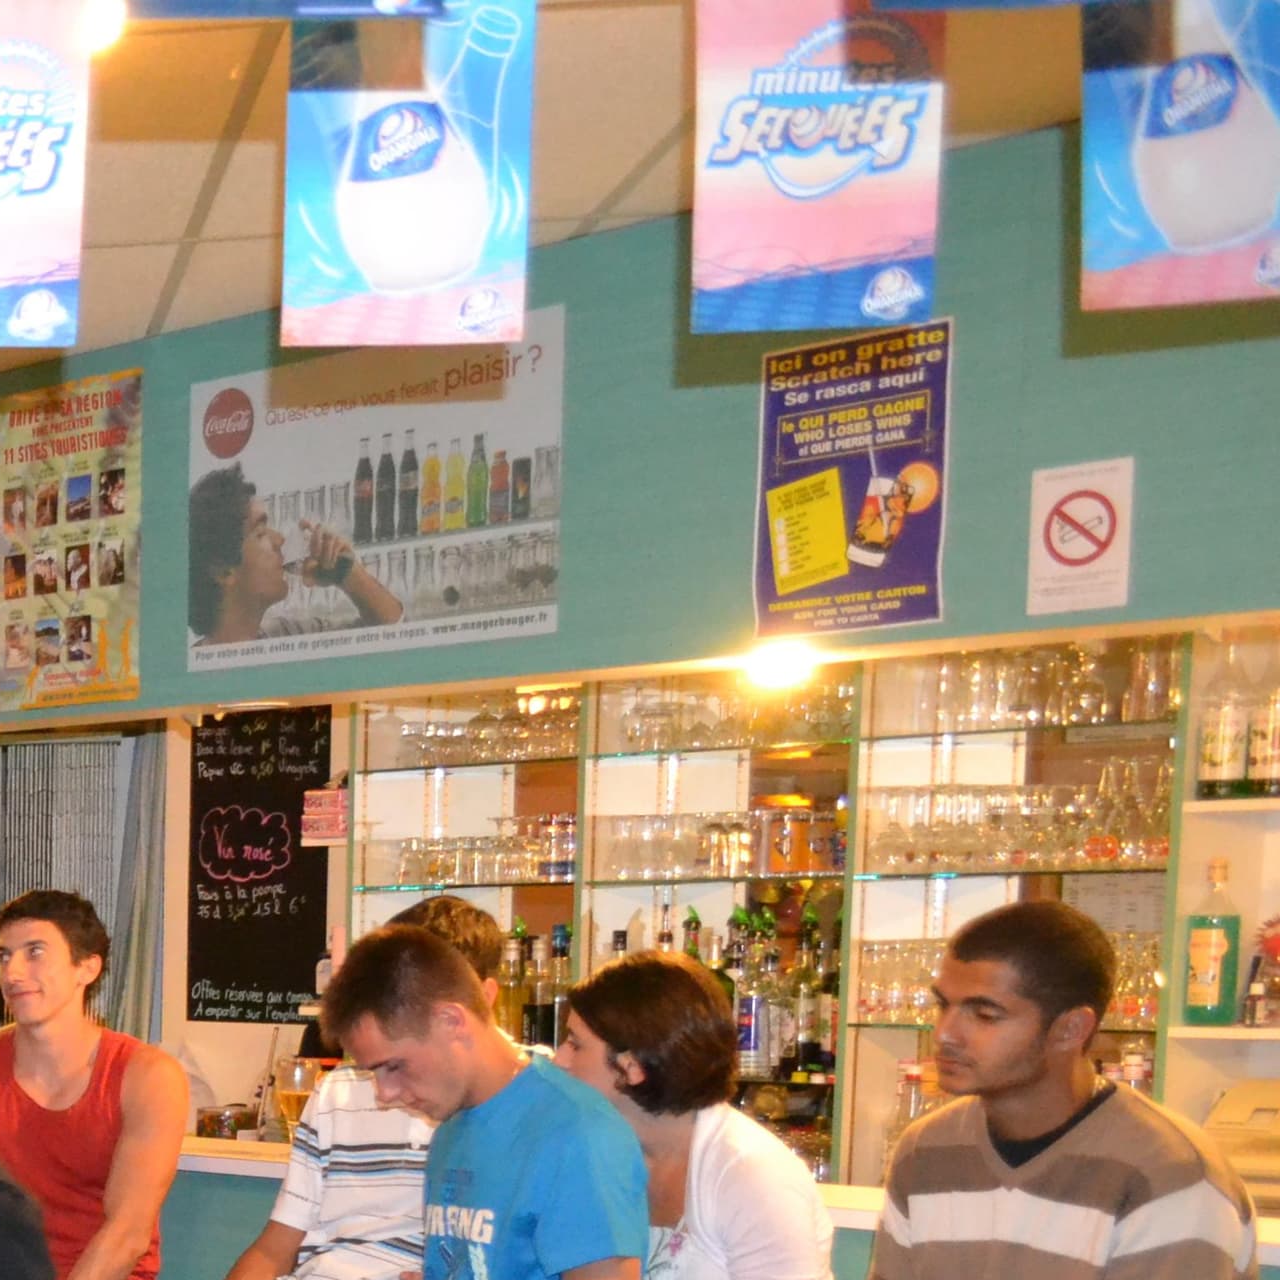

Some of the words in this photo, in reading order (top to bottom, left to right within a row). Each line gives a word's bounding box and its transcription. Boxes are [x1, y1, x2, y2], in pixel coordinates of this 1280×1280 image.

[770, 354, 803, 374] Ici
[812, 350, 847, 366] on
[856, 329, 945, 361] gratte
[770, 361, 871, 392] Scratch
[881, 349, 943, 370] here
[443, 350, 522, 396] plaisir
[784, 391, 809, 406] Se
[815, 380, 872, 400] rasca
[794, 429, 824, 444] WHO
[829, 421, 872, 439] LOSES
[876, 414, 912, 430] WINS
[799, 415, 824, 430] QUI
[828, 407, 868, 425] PERD
[872, 397, 926, 416] GAGNE
